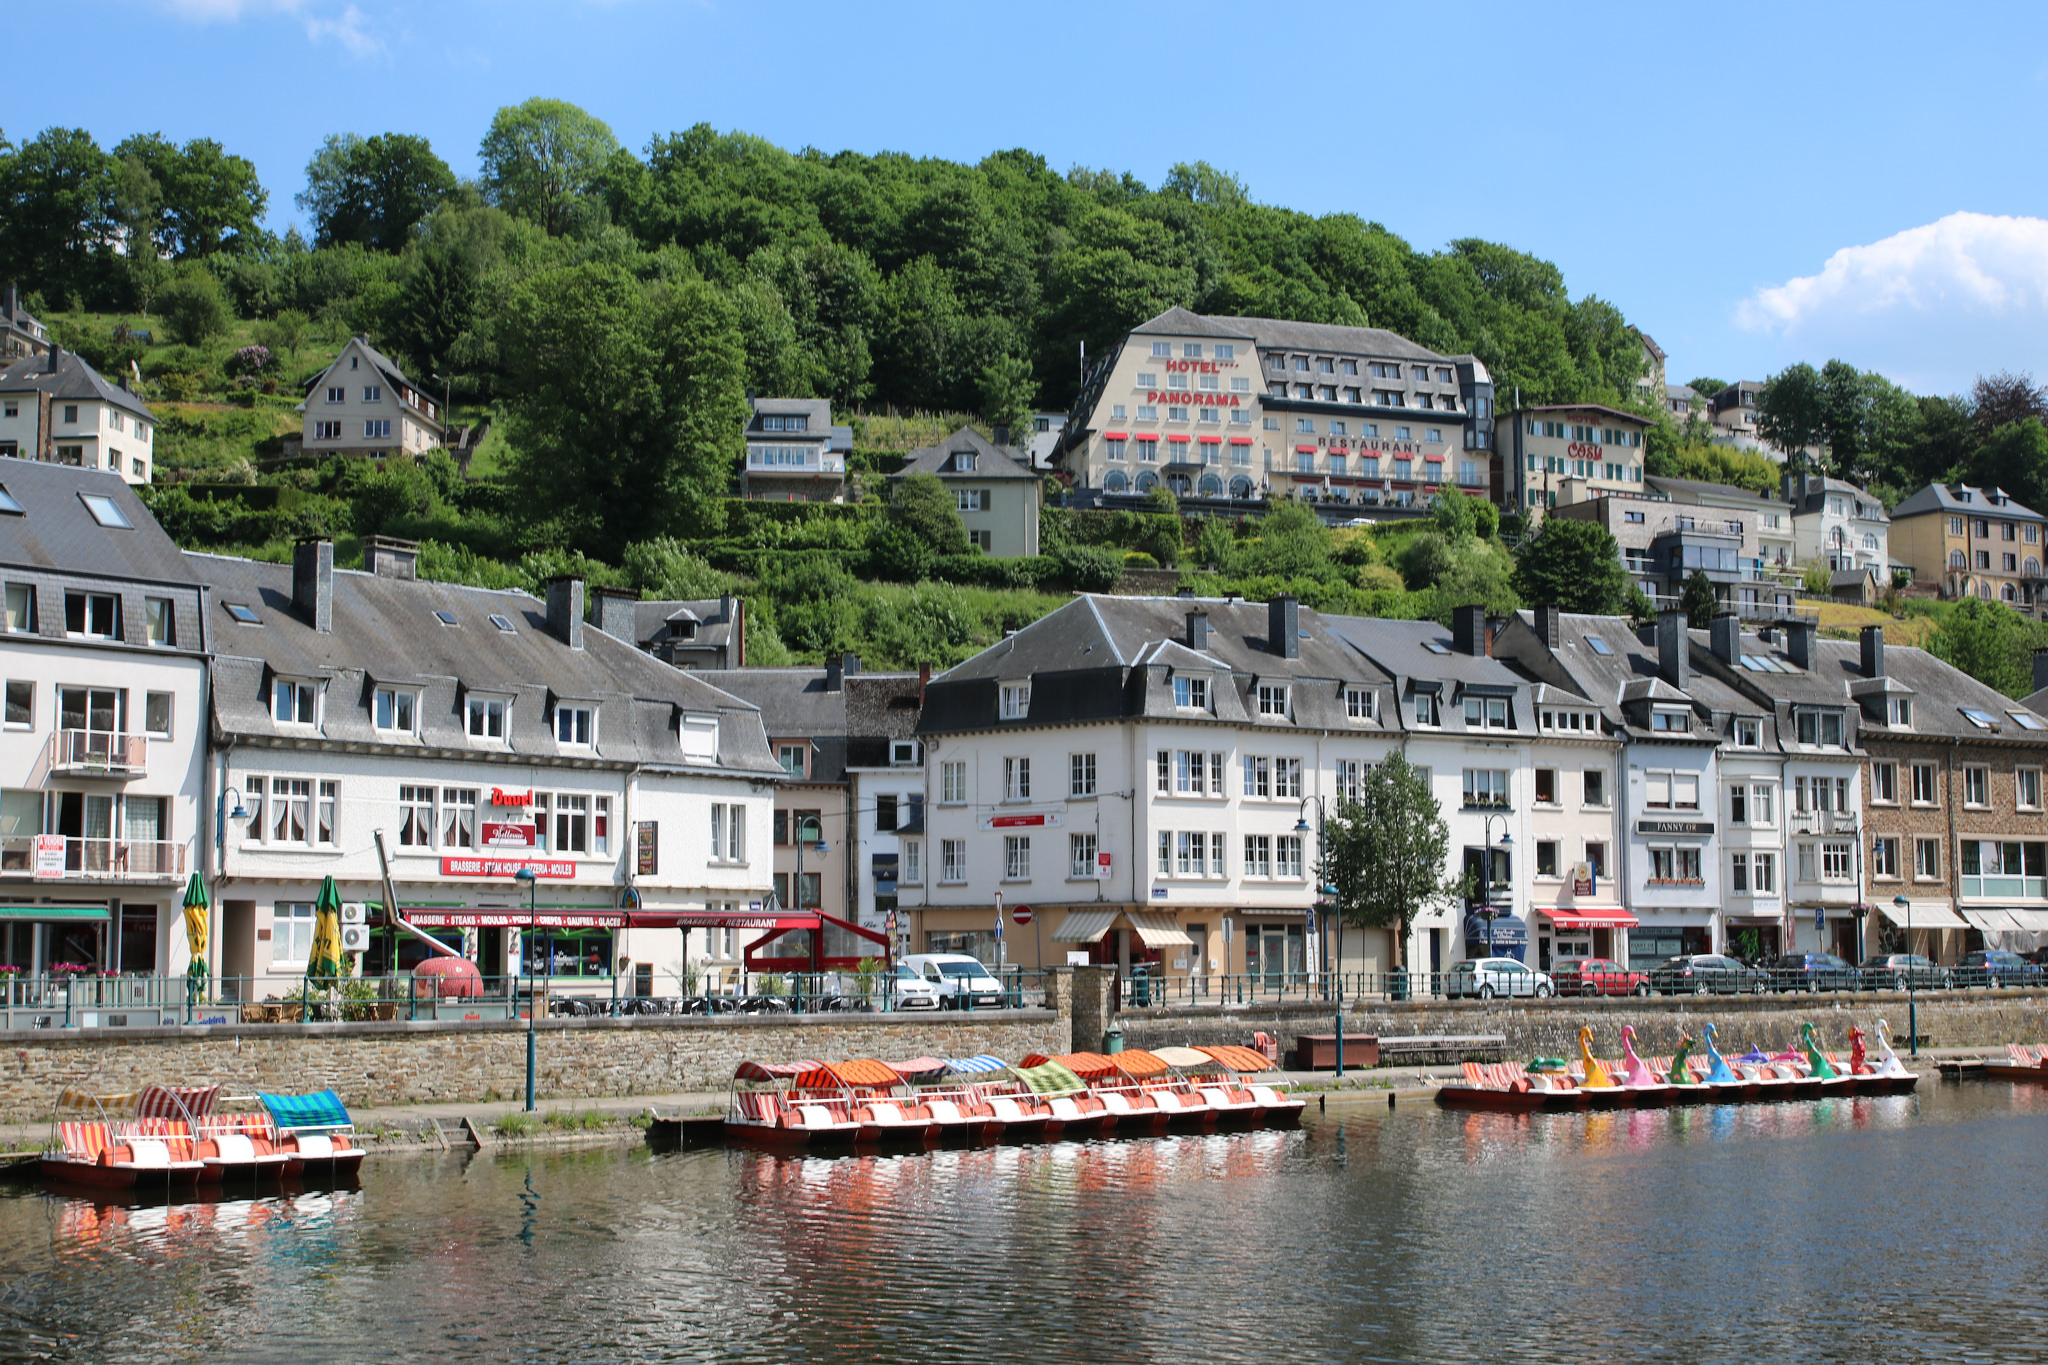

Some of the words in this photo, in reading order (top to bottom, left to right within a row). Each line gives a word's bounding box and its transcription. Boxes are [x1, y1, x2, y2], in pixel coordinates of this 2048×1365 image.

[1166, 360, 1220, 374] HOTEL
[1147, 391, 1240, 407] PANORAMA
[1567, 413, 1603, 425] HOTEL
[1317, 436, 1422, 454] RESTAURANT
[491, 787, 534, 807] Duvel
[1657, 821, 1684, 832] FANNY
[1686, 823, 1697, 832] OR
[450, 861, 481, 873] BRASSERIE
[484, 861, 502, 873] STEAK
[503, 862, 521, 874] HOUSE
[551, 863, 573, 876] MOULES
[410, 915, 445, 925] BRASSERIE
[450, 915, 476, 926] STEAKS
[481, 915, 508, 926] MOULES
[566, 916, 595, 926] GAUFRES
[598, 917, 621, 927] GLACES
[676, 918, 720, 926] BRASSERIE
[726, 918, 777, 928] RESTAURANT
